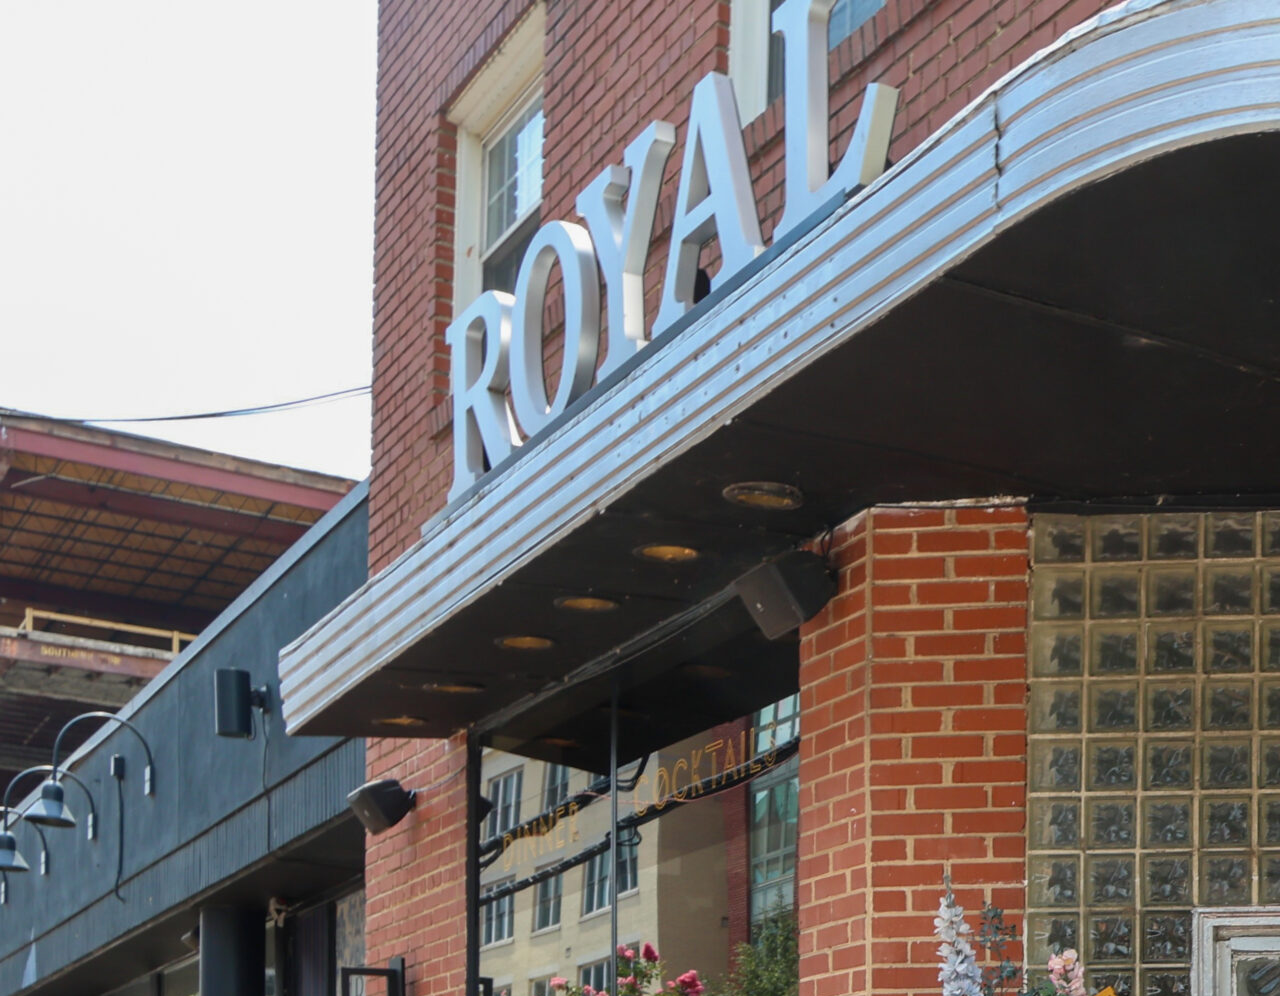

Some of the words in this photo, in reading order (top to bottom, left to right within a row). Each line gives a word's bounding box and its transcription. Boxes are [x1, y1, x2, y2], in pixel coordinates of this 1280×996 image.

[446, 0, 899, 506] ROYAL
[633, 720, 777, 817] COCKTAILS
[503, 801, 579, 873] DINNER
